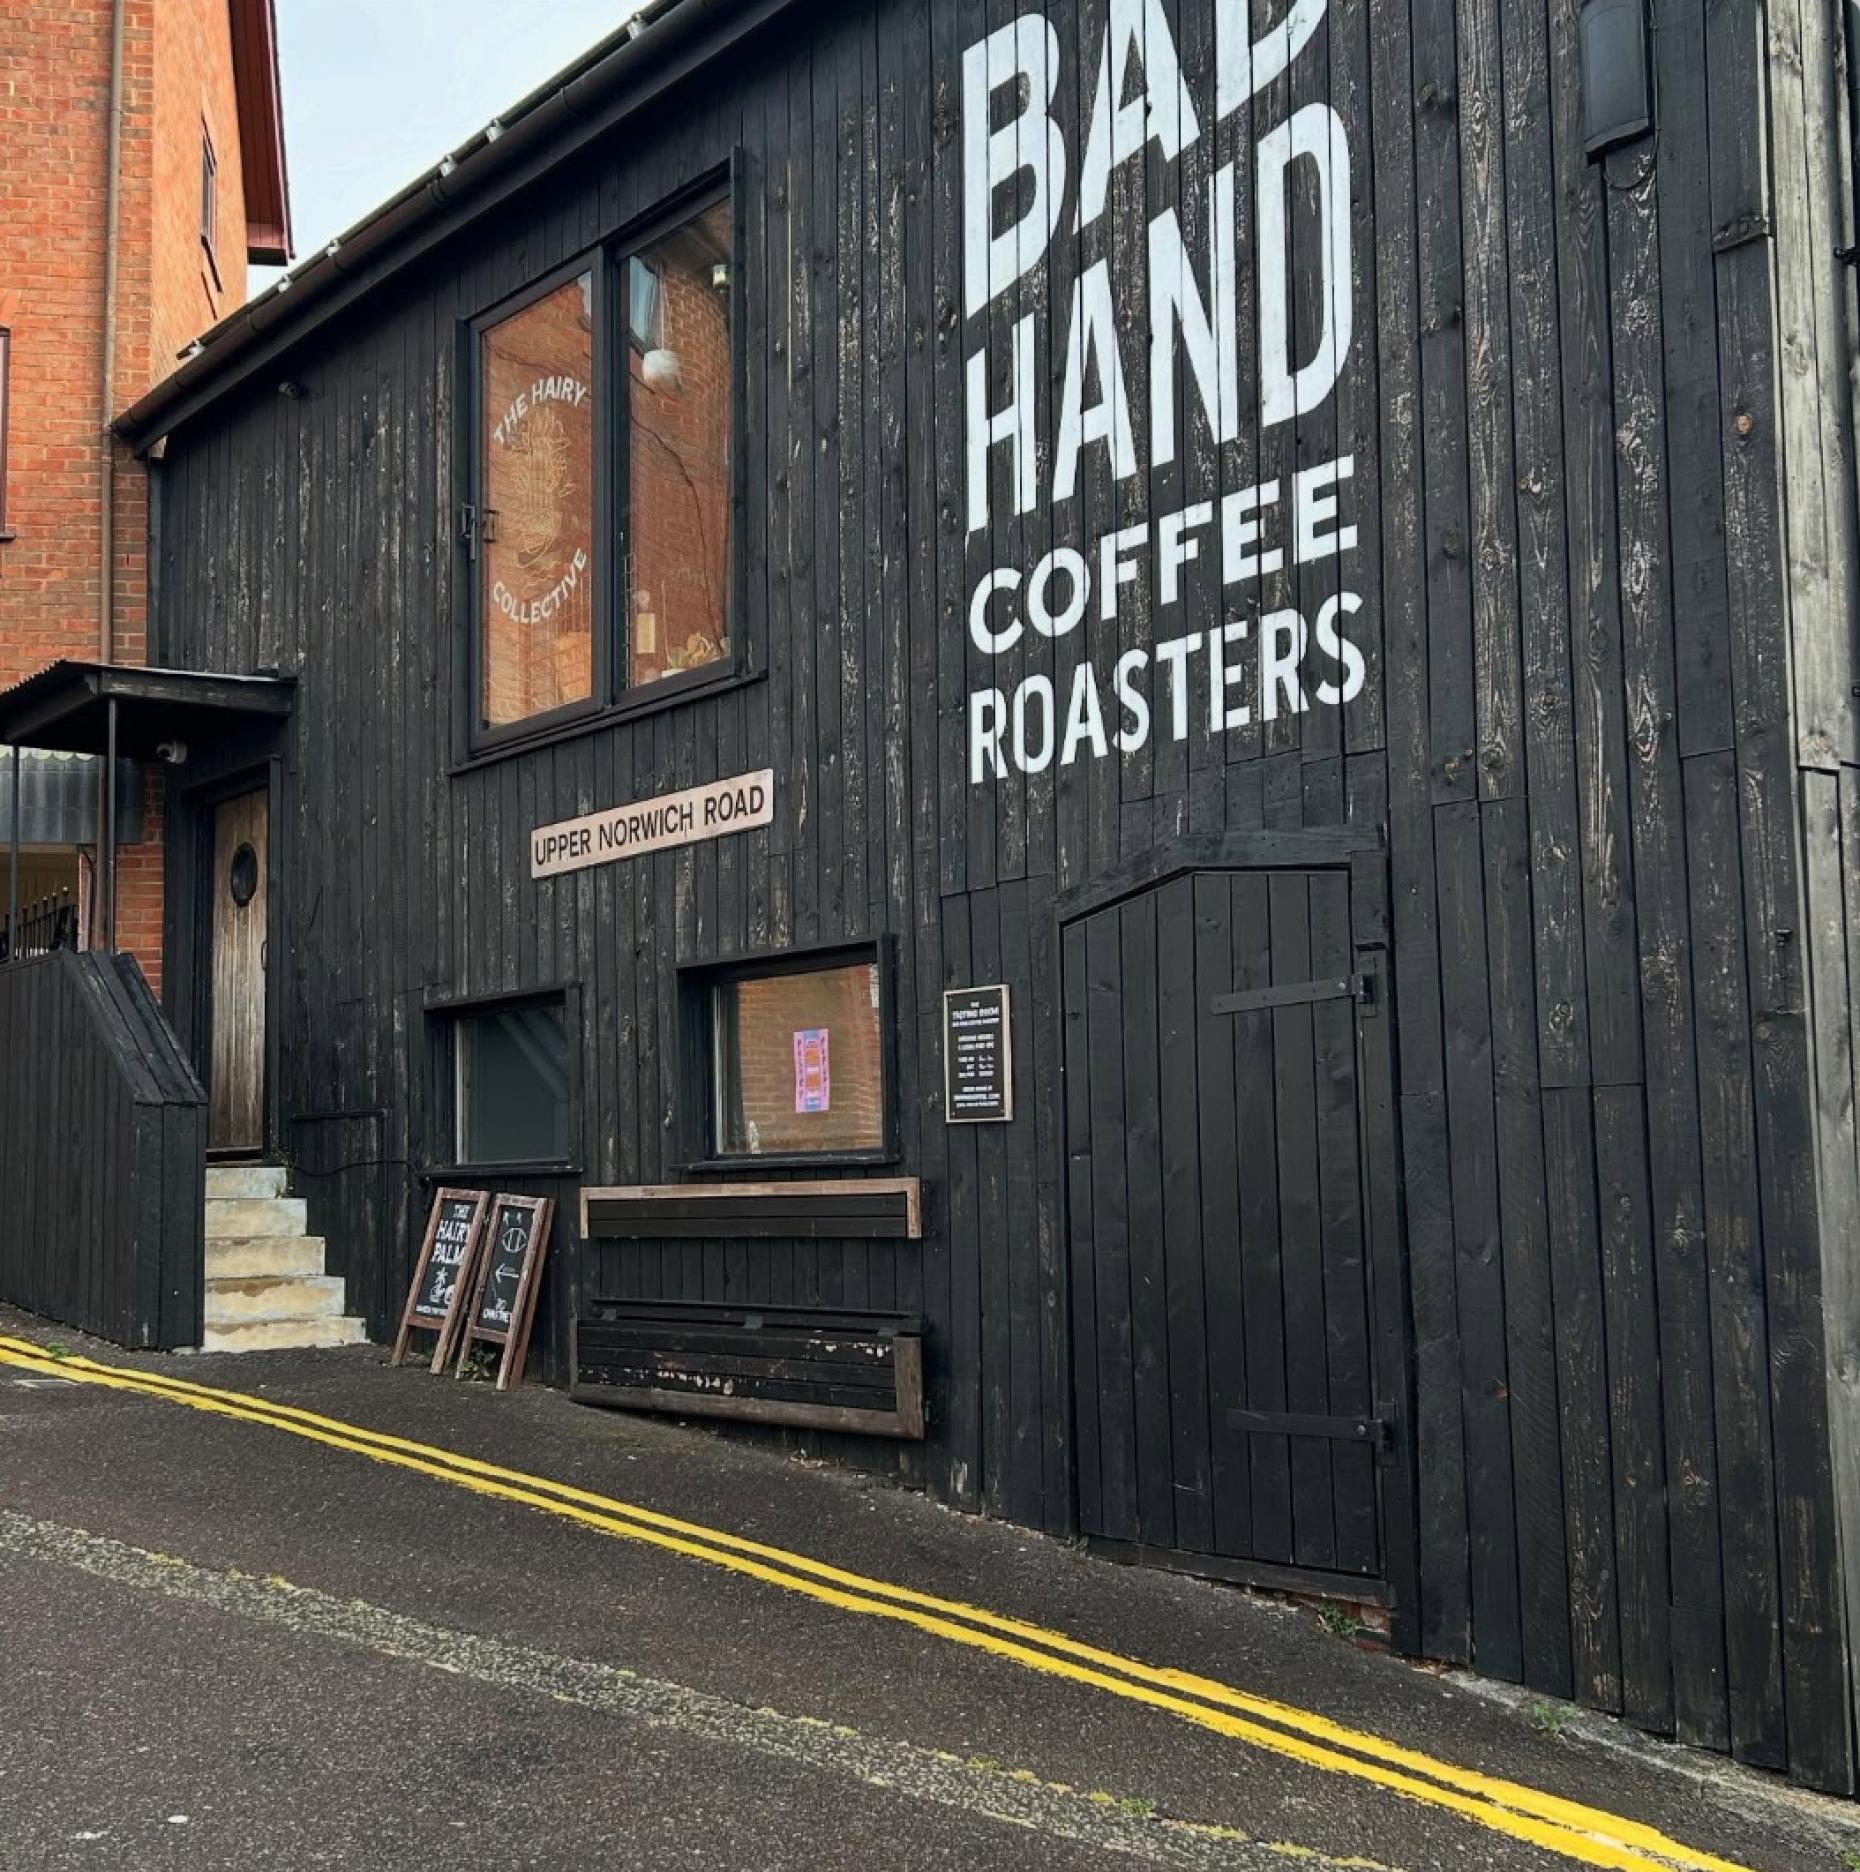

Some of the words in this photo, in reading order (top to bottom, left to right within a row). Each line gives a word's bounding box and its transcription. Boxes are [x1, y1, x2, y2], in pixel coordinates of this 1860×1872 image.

[966, 102, 1352, 532] HAND
[493, 391, 528, 444] THE
[532, 376, 587, 408] HAIRY
[493, 547, 587, 624] COLLECTIVE
[969, 454, 1358, 654] COFFEE
[970, 591, 1366, 783] ROASTERS
[534, 828, 591, 865] UPPER
[599, 802, 693, 852] NORWICH
[704, 785, 765, 826] ROAD
